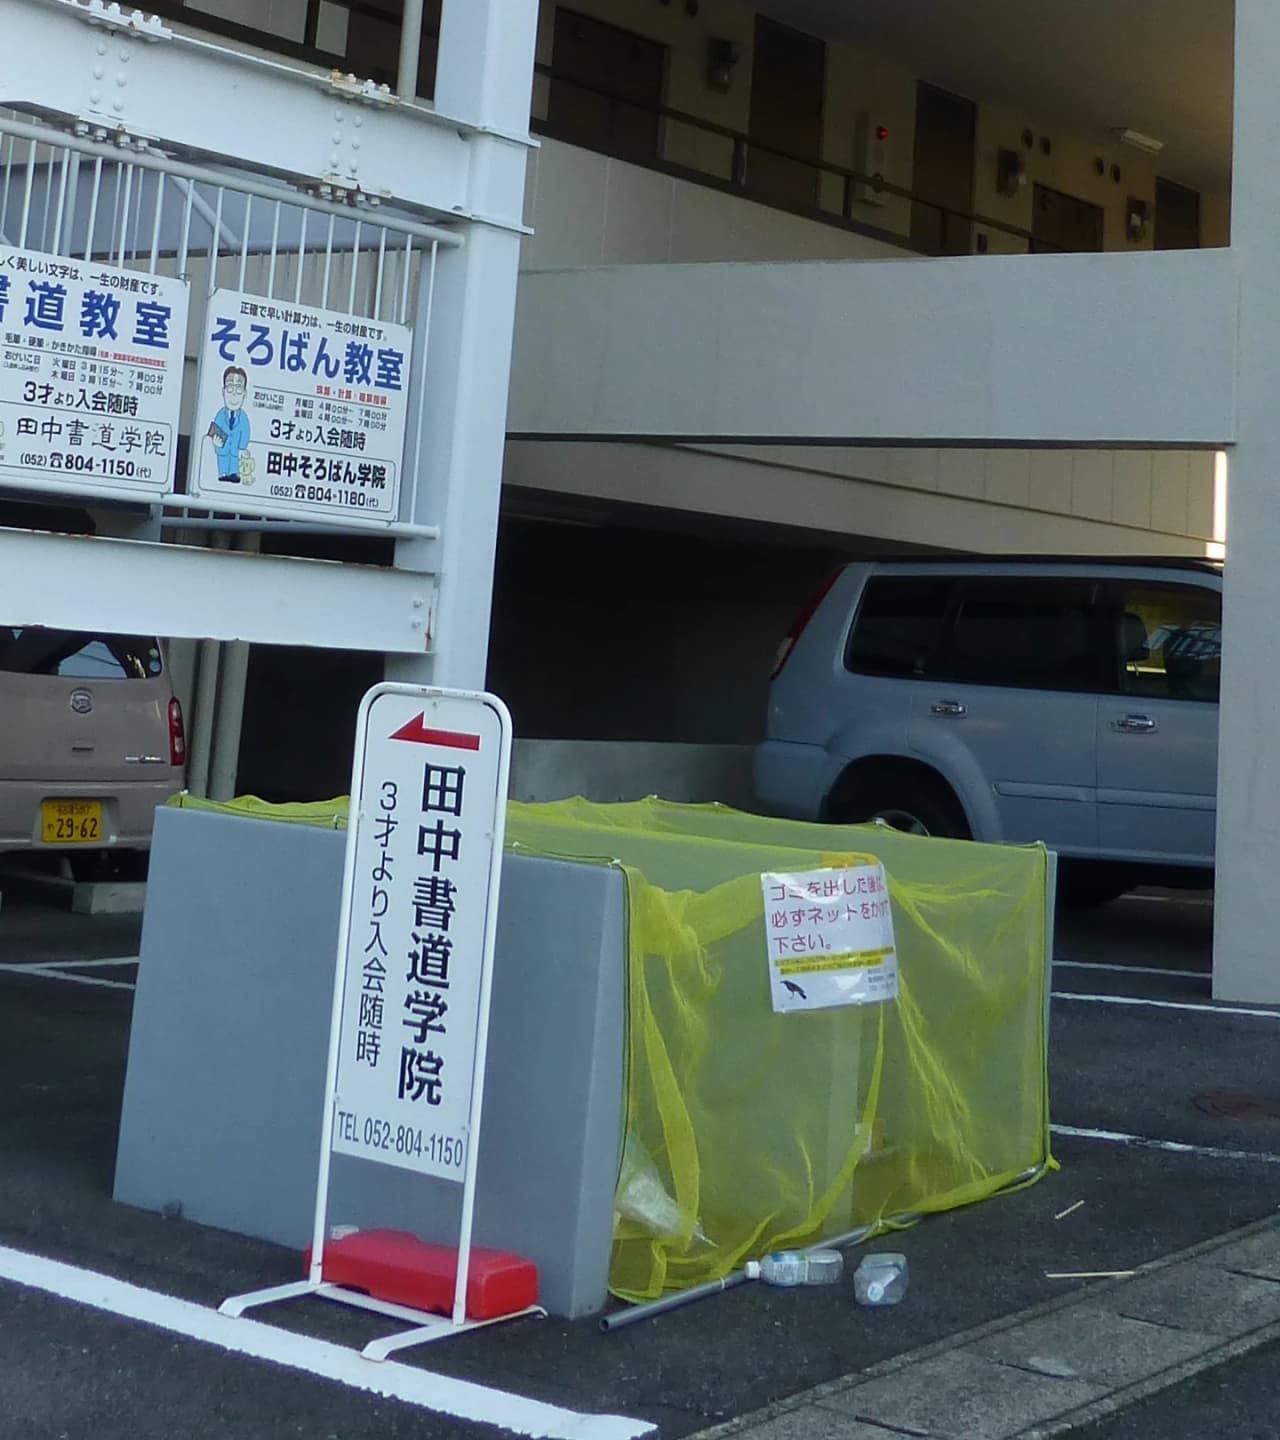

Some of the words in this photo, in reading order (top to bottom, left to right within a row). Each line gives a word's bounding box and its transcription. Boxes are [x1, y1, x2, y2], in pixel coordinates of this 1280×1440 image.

[210, 316, 404, 391] そろばん教室
[23, 380, 139, 417] 3才より入会随時
[16, 415, 166, 457] 田中書道学院
[270, 418, 366, 451] 3才より入会随時
[266, 451, 386, 490] 田中そろばん学院
[356, 781, 399, 1067] 3才より入会随時
[397, 762, 466, 1106] 田中書道学院
[772, 933, 832, 954] 下さい。
[338, 1111, 360, 1142] TEL
[363, 1117, 463, 1168] 052-804-1150
